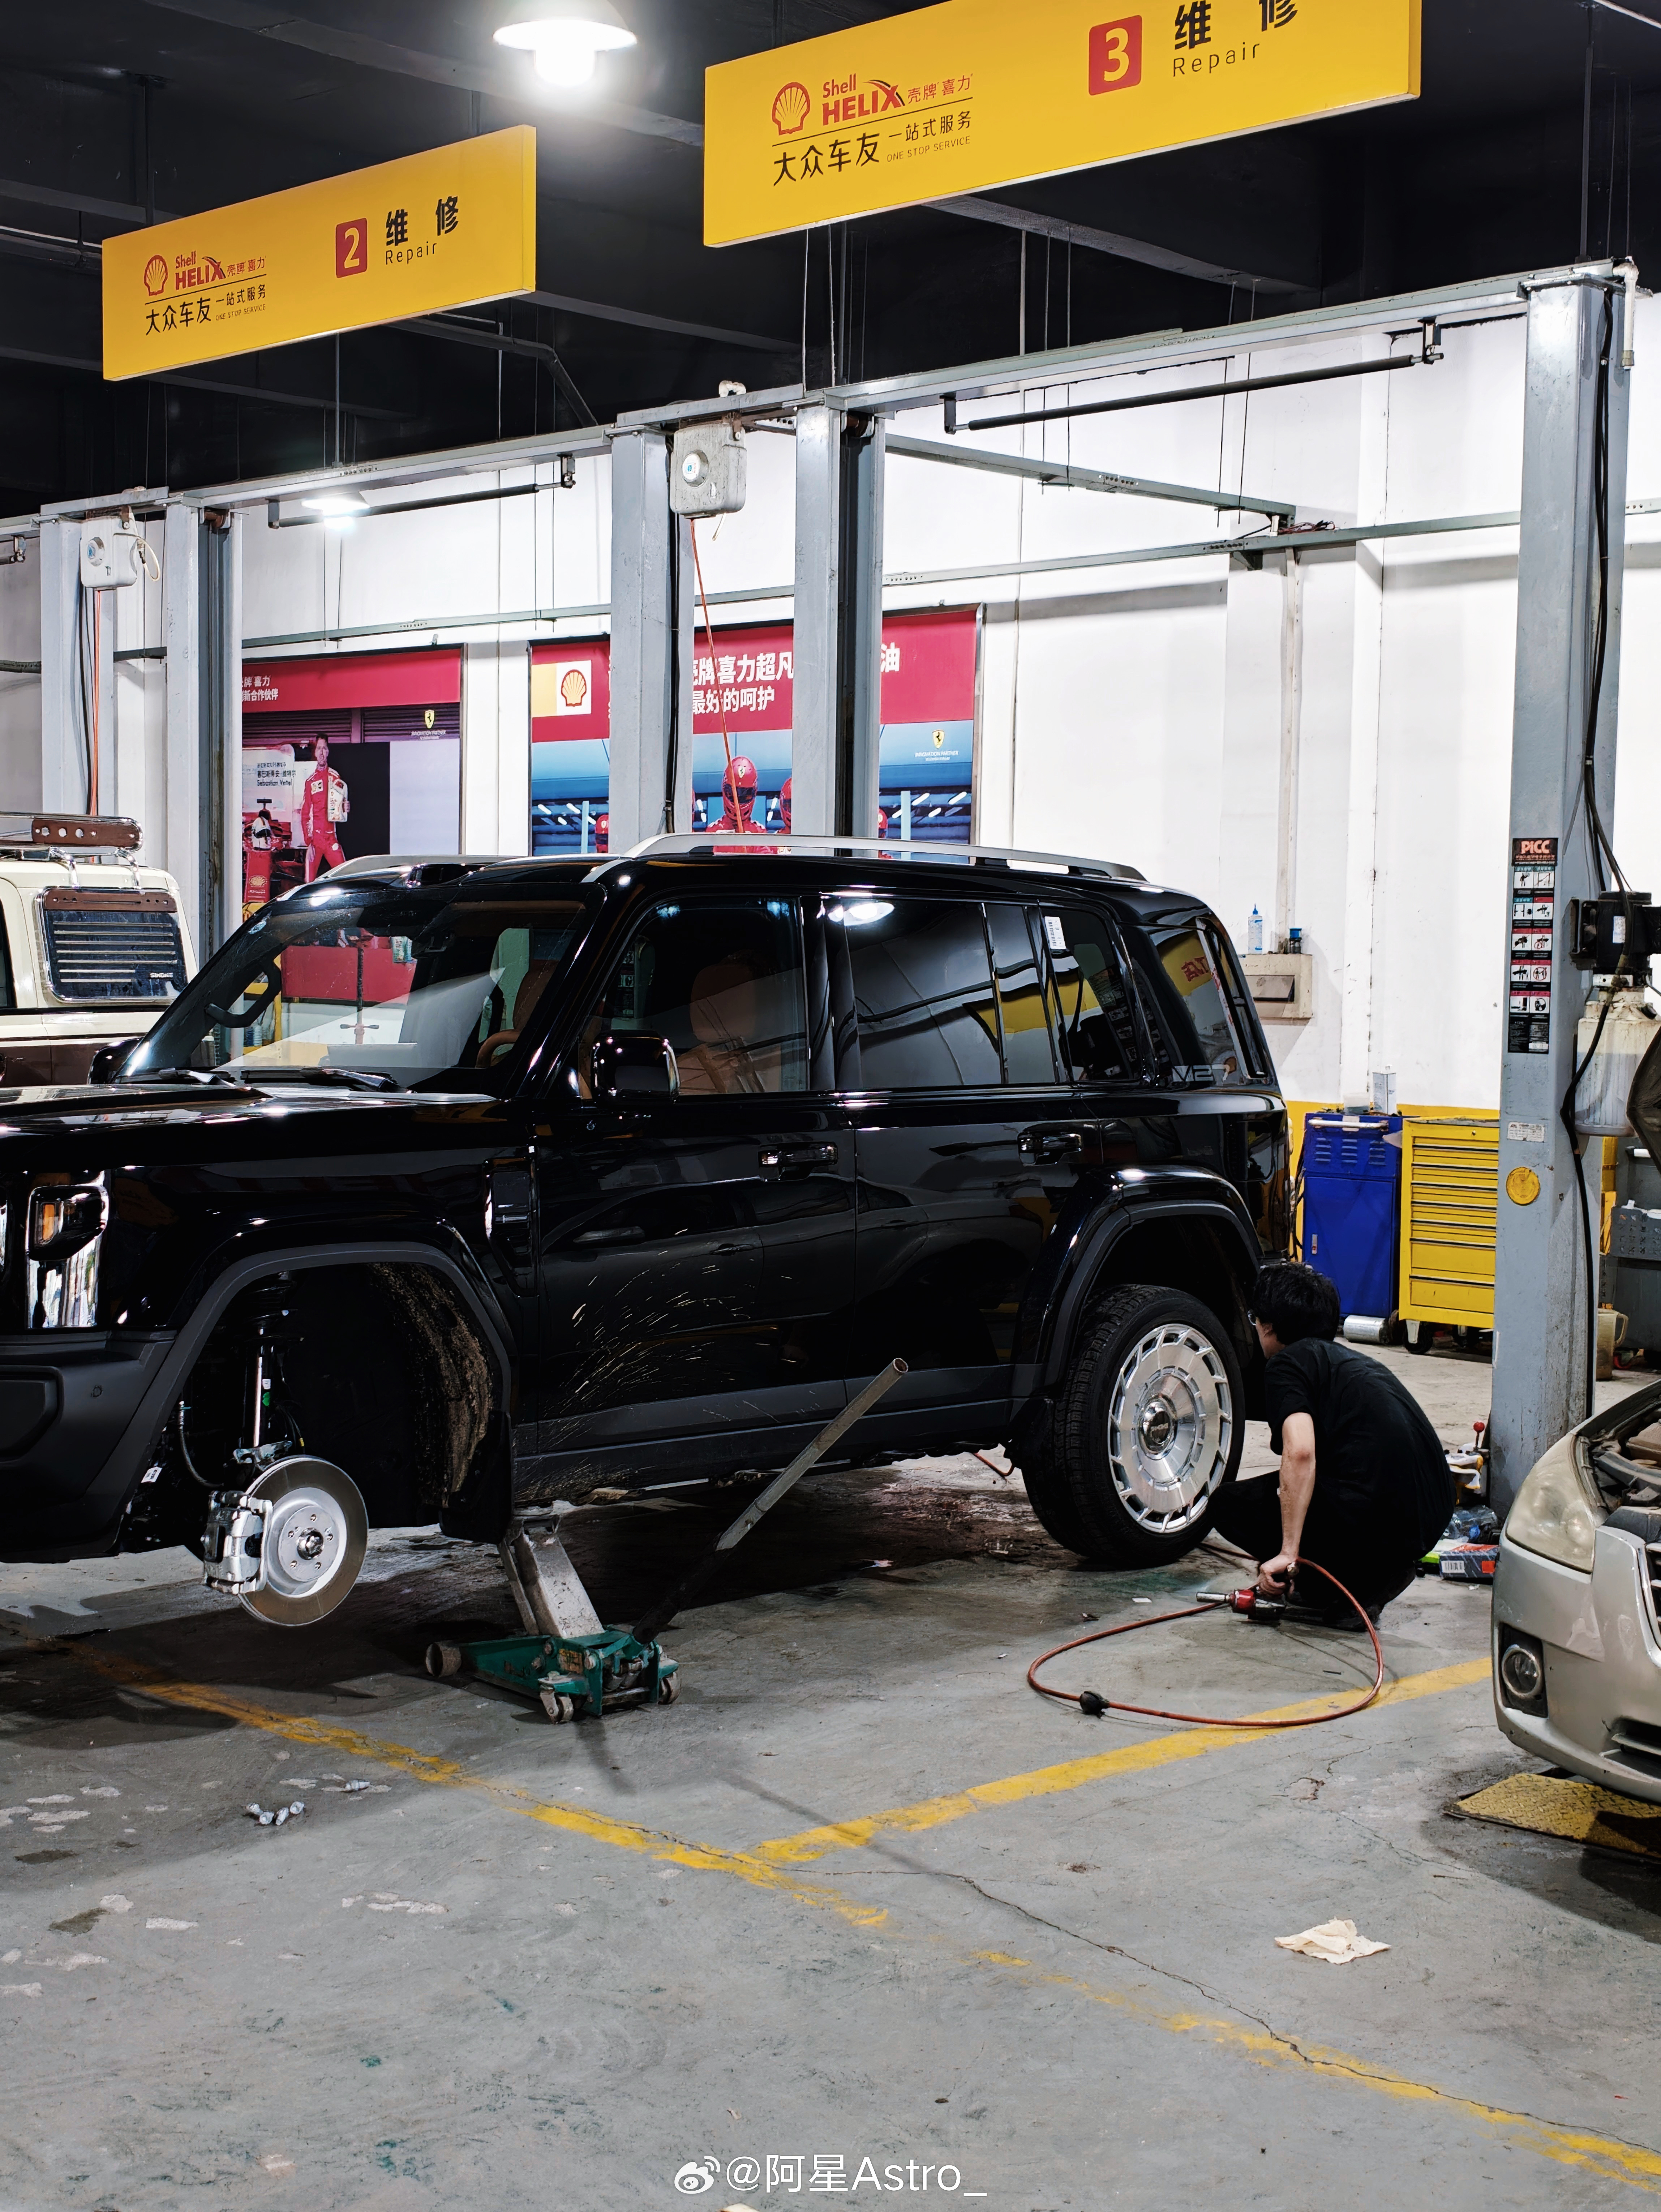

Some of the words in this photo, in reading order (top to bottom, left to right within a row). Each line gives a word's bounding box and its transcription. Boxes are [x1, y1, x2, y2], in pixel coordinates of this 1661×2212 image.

[1175, 0, 1299, 50] 维修
[1103, 27, 1130, 82] 3
[1173, 42, 1260, 77] Repair
[823, 73, 857, 98] Shell
[907, 74, 972, 104] 壳牌喜力
[822, 80, 905, 126] HELIX
[889, 110, 971, 141] 一站式服务
[773, 132, 880, 187] 大众车友
[887, 151, 904, 162] ONE
[907, 145, 930, 159] STOP
[933, 135, 970, 152] SERVICE
[386, 196, 459, 247] 维修
[175, 250, 196, 269] Shell
[344, 227, 360, 269] 2
[386, 241, 437, 265] Repair
[175, 256, 226, 291] HELIX
[216, 284, 266, 306] 一站式服务
[228, 309, 241, 318] STOP
[244, 303, 266, 314] SERVICE
[146, 297, 211, 335] 大众车友
[242, 675, 271, 687] 牌喜力
[693, 652, 794, 686] 牌喜力超凡
[1521, 840, 1550, 854] PICC
